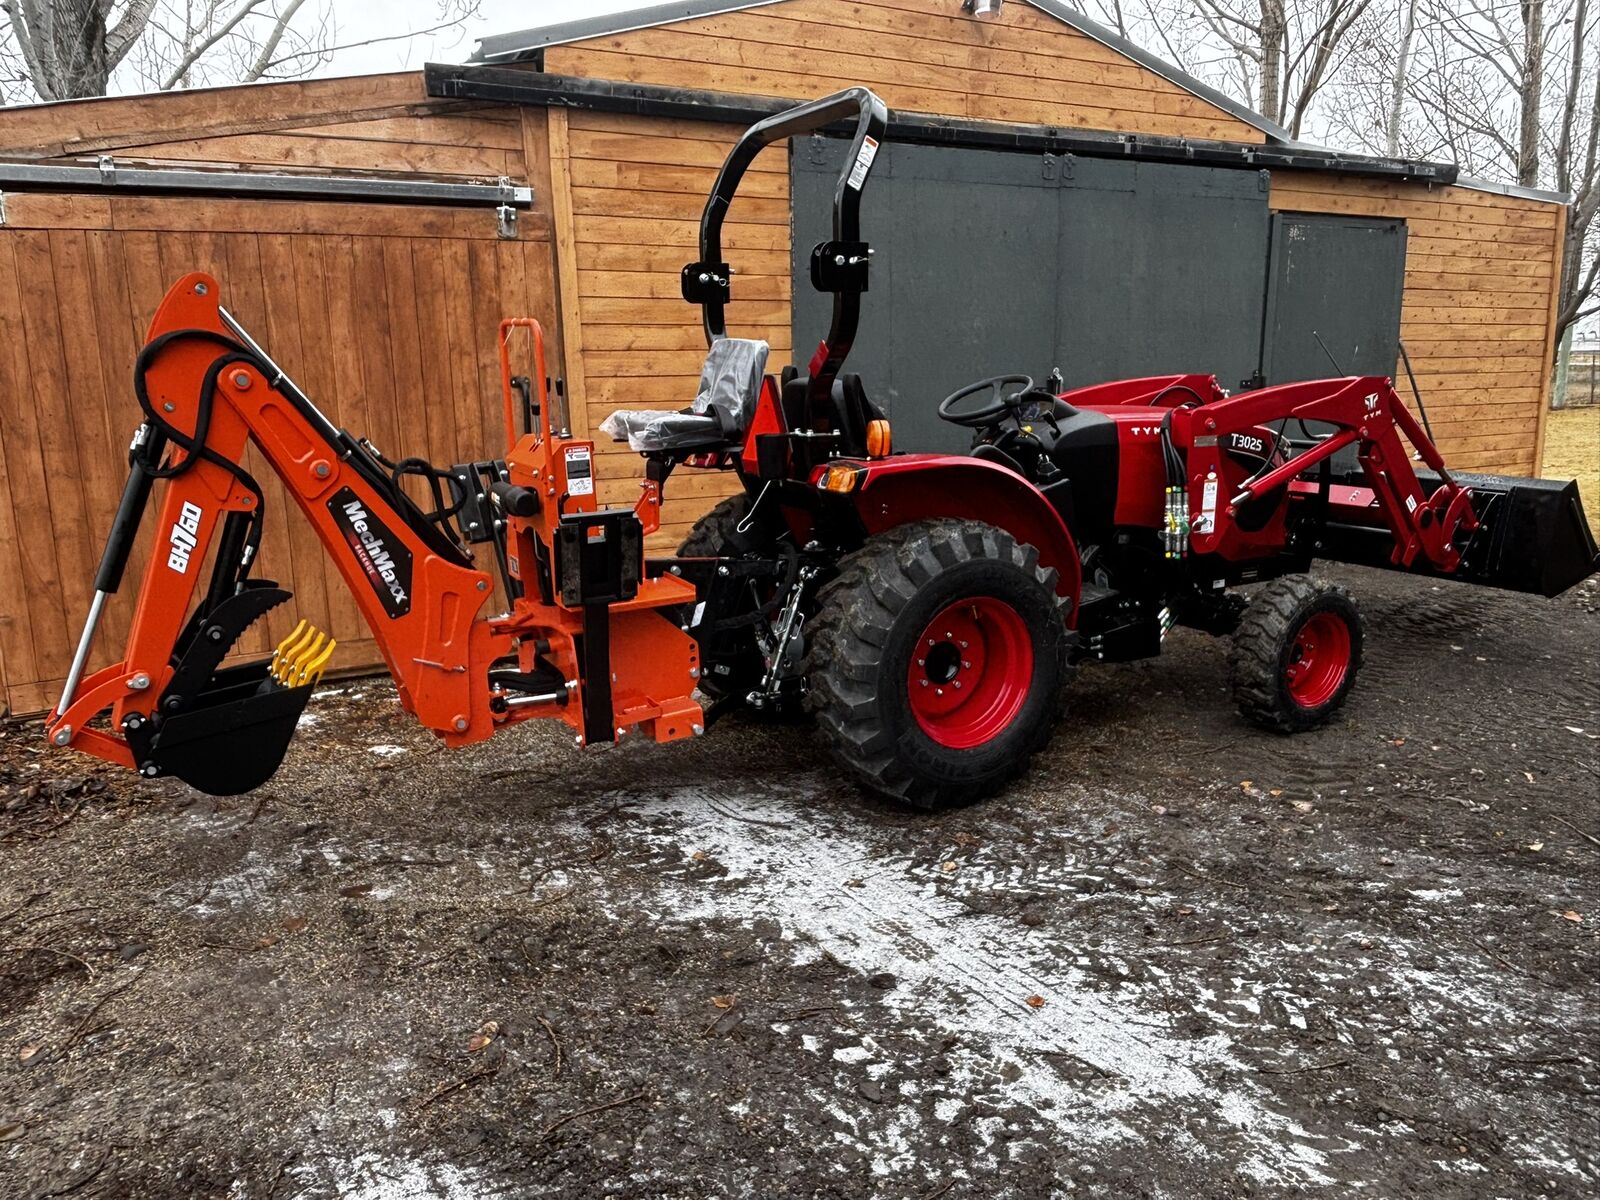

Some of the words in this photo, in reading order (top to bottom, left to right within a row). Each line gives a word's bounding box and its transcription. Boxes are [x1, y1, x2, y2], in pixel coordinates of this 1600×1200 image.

[1363, 409, 1382, 421] TYM
[1131, 426, 1161, 436] TYM
[1231, 433, 1263, 452] T3025
[167, 500, 203, 575] BH760
[342, 500, 408, 605] MechMaxx
